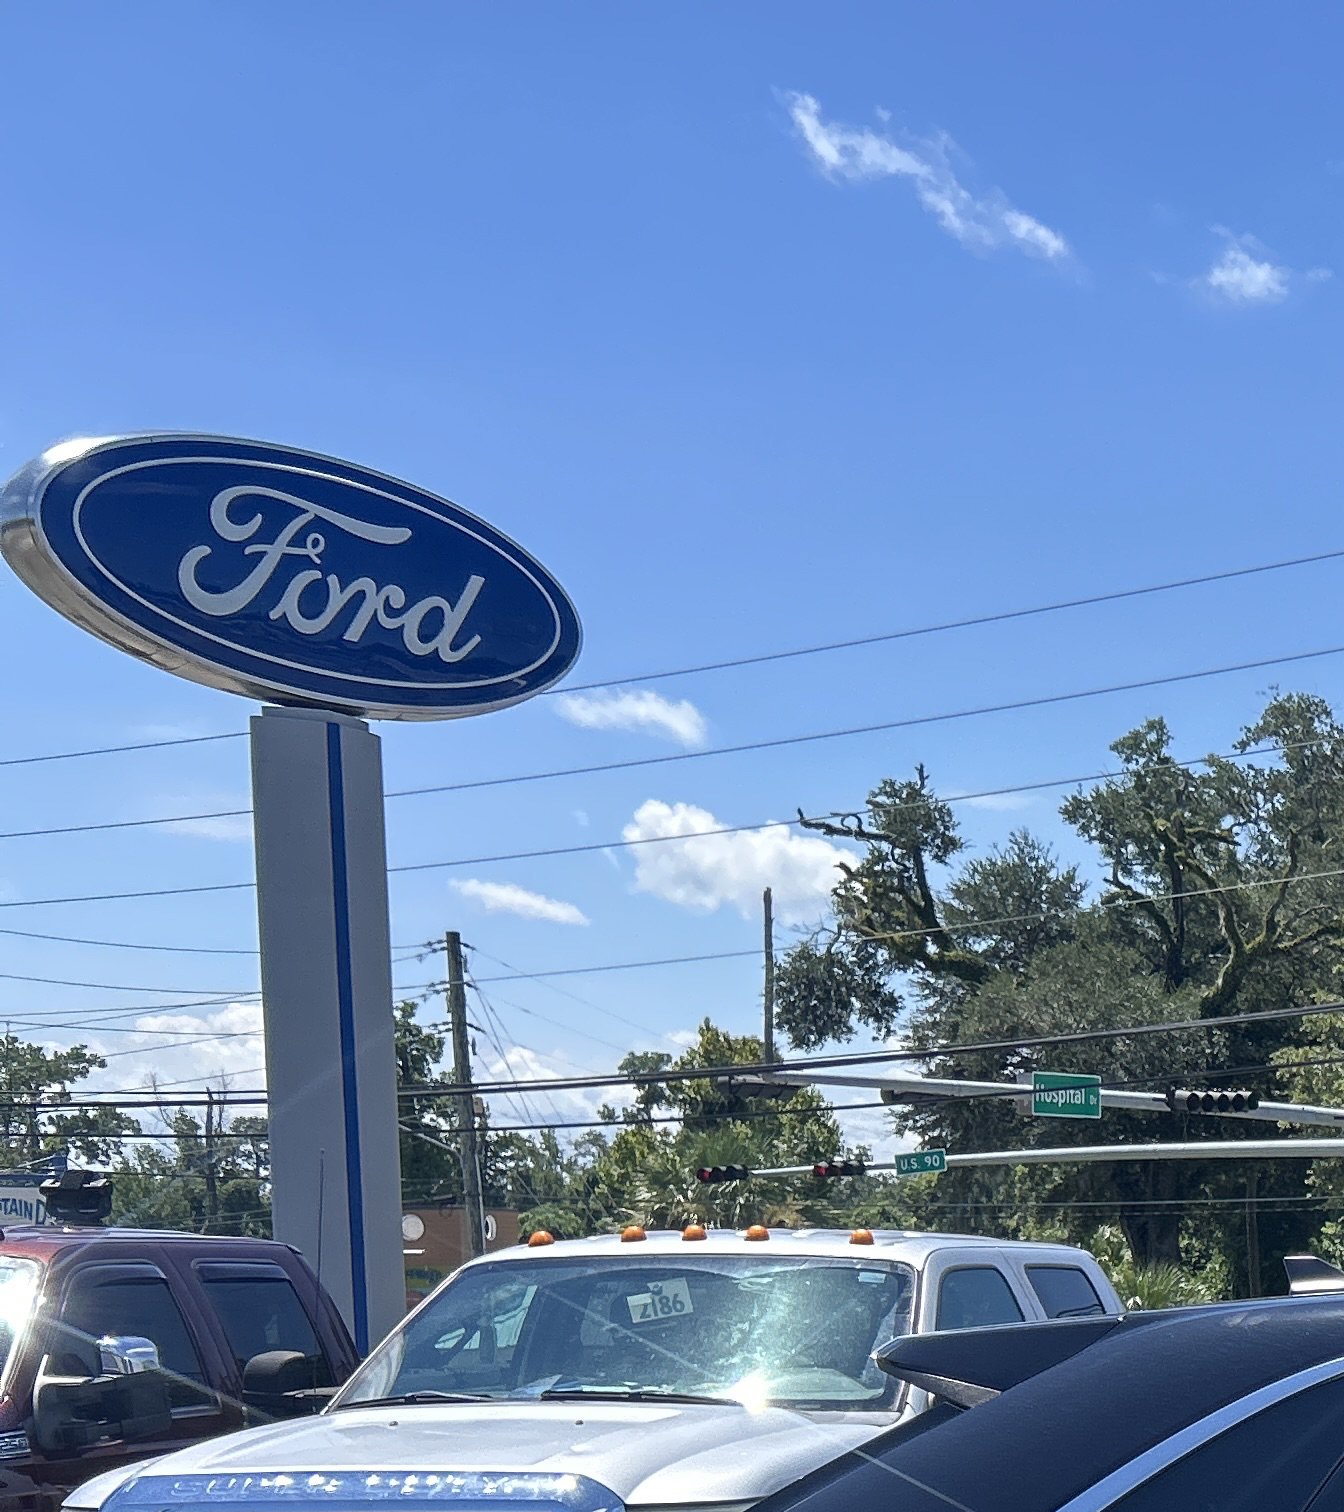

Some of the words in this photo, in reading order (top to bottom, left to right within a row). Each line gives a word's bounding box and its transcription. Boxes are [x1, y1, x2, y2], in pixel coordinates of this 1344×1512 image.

[178, 485, 485, 663] Ford
[1036, 1083, 1085, 1107] Hospital
[900, 1158, 921, 1171] U.S.
[924, 1154, 940, 1168] 90
[0, 1198, 33, 1221] TAIN
